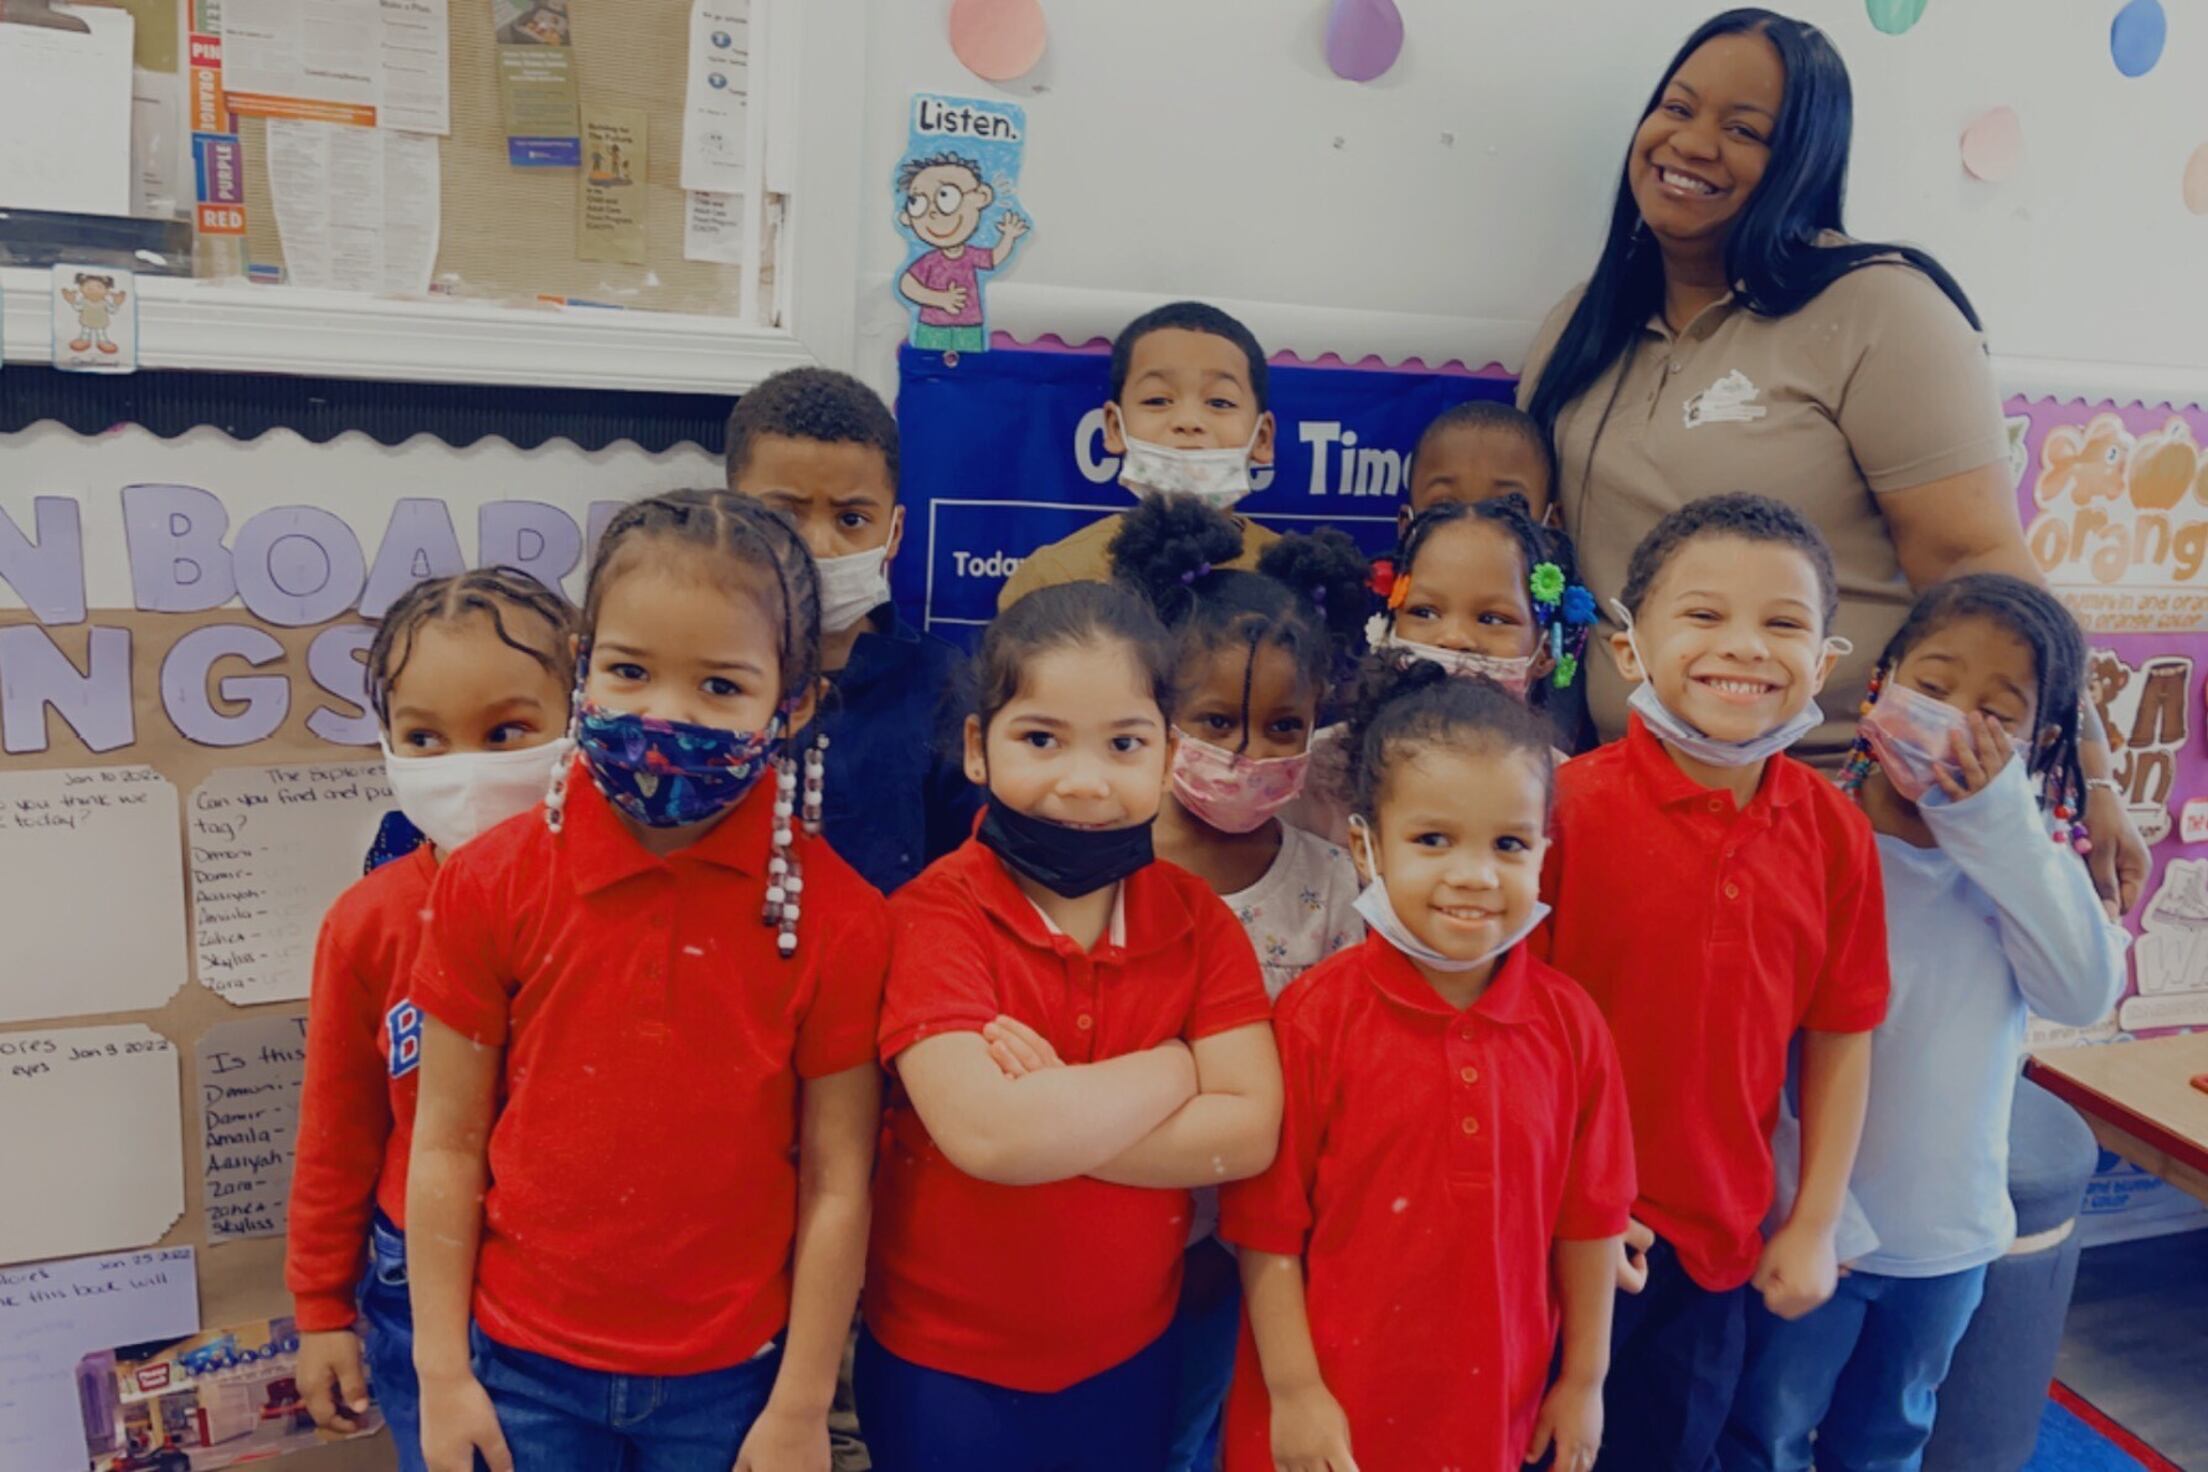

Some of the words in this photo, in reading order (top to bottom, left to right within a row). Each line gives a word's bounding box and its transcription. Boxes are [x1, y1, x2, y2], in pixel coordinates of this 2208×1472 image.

[919, 100, 1018, 139] Listen.
[216, 144, 235, 200] PURPLE
[203, 209, 243, 229] RED
[1298, 421, 1412, 497] Tim
[121, 484, 623, 628] BOAR
[952, 550, 1025, 577] Toda
[196, 790, 231, 811] Can
[194, 813, 248, 842] tag?
[258, 1045, 306, 1064] this
[385, 998, 424, 1079] B
